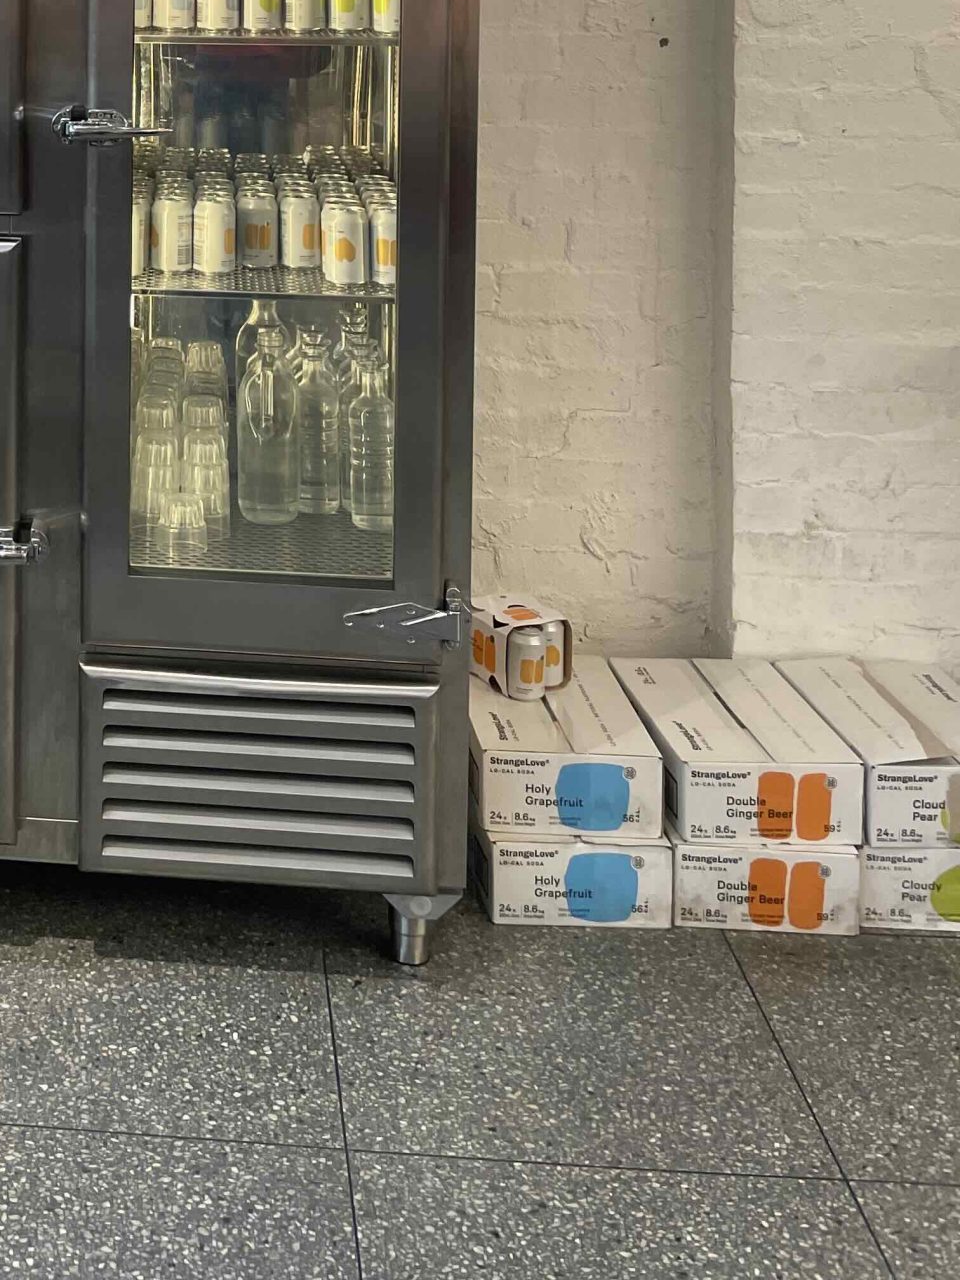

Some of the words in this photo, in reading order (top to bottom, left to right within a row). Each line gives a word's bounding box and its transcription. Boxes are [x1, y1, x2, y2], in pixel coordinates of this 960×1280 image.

[525, 784, 551, 795] Holy
[525, 796, 584, 808] Grapefruit
[726, 796, 766, 806] Double
[912, 799, 946, 810] Cloud
[623, 813, 634, 822] 56
[726, 809, 764, 820] Ginger
[768, 809, 793, 819] Beer
[912, 812, 938, 822] Pear
[823, 824, 836, 833] 59
[534, 875, 561, 887] Holy
[717, 880, 757, 891] Double
[901, 880, 942, 892] Cloudy
[534, 888, 592, 900] Grapefruit
[717, 893, 755, 905] Ginger
[759, 894, 785, 905] Beer
[901, 892, 928, 902] Pear
[631, 904, 643, 913] 56
[816, 912, 829, 921] 59
